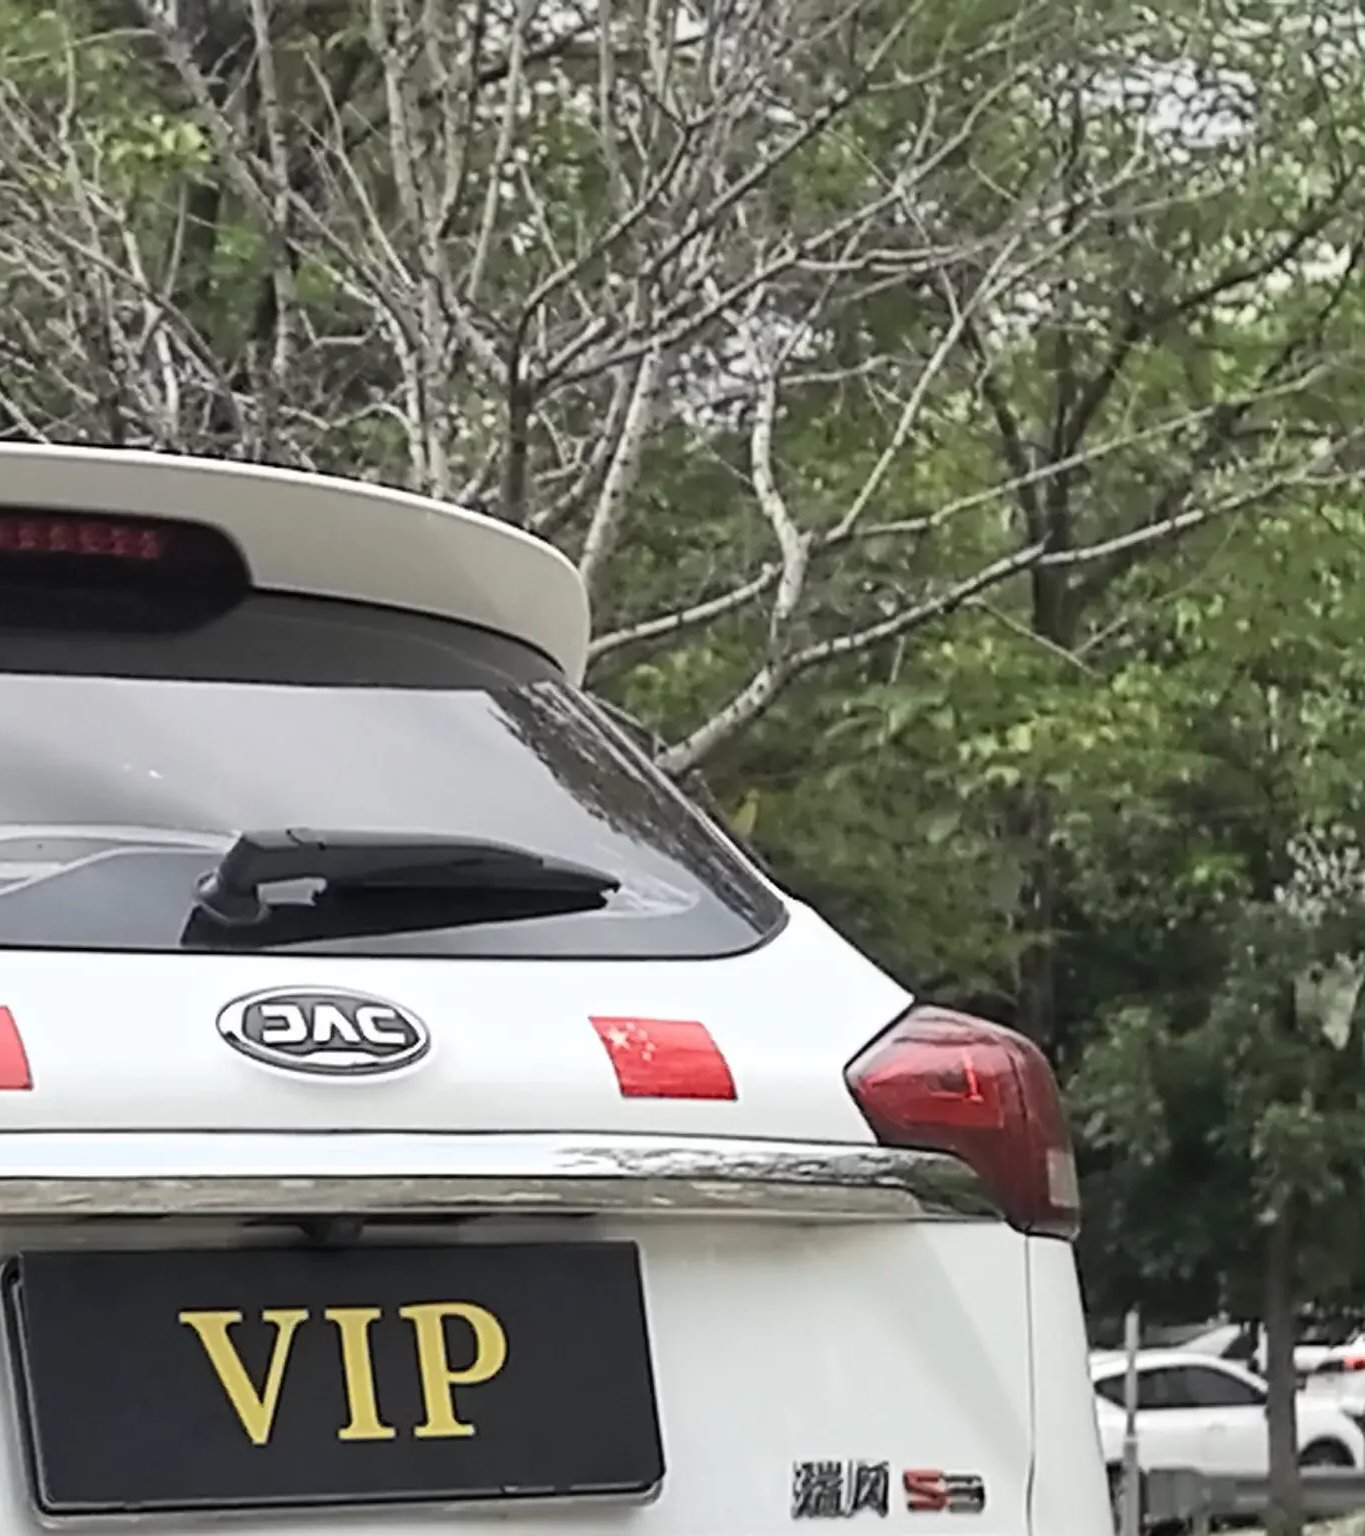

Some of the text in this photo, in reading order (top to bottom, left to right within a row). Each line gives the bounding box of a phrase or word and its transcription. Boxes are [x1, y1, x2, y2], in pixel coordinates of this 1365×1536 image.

[260, 1002, 407, 1046] JAC
[178, 1301, 508, 1445] VIP
[791, 1460, 987, 1520] 瑞风 S3
